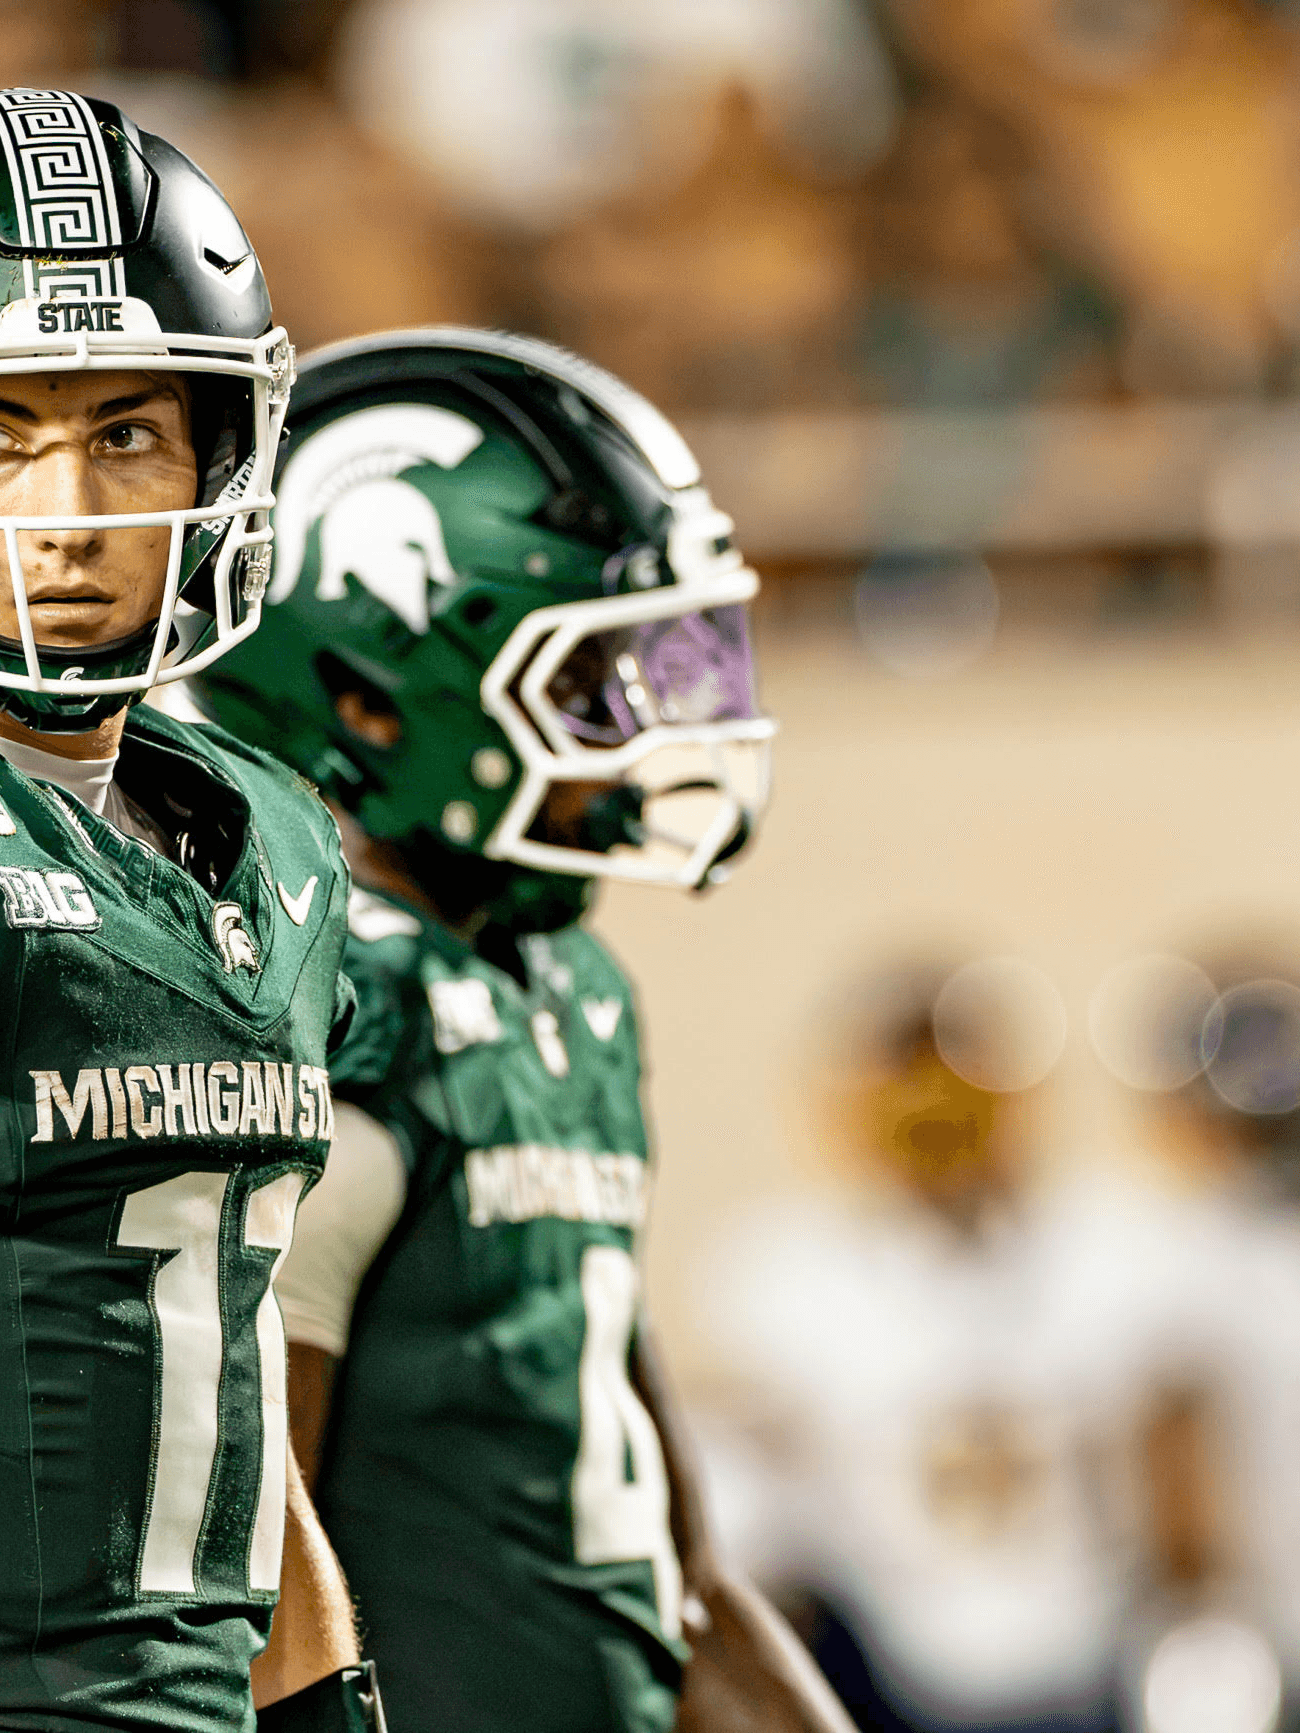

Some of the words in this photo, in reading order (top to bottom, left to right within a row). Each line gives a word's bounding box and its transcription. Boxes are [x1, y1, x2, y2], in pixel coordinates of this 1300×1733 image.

[37, 301, 125, 334] STATE
[28, 1060, 293, 1143] MICHIGAN
[115, 1170, 306, 1593] 11
